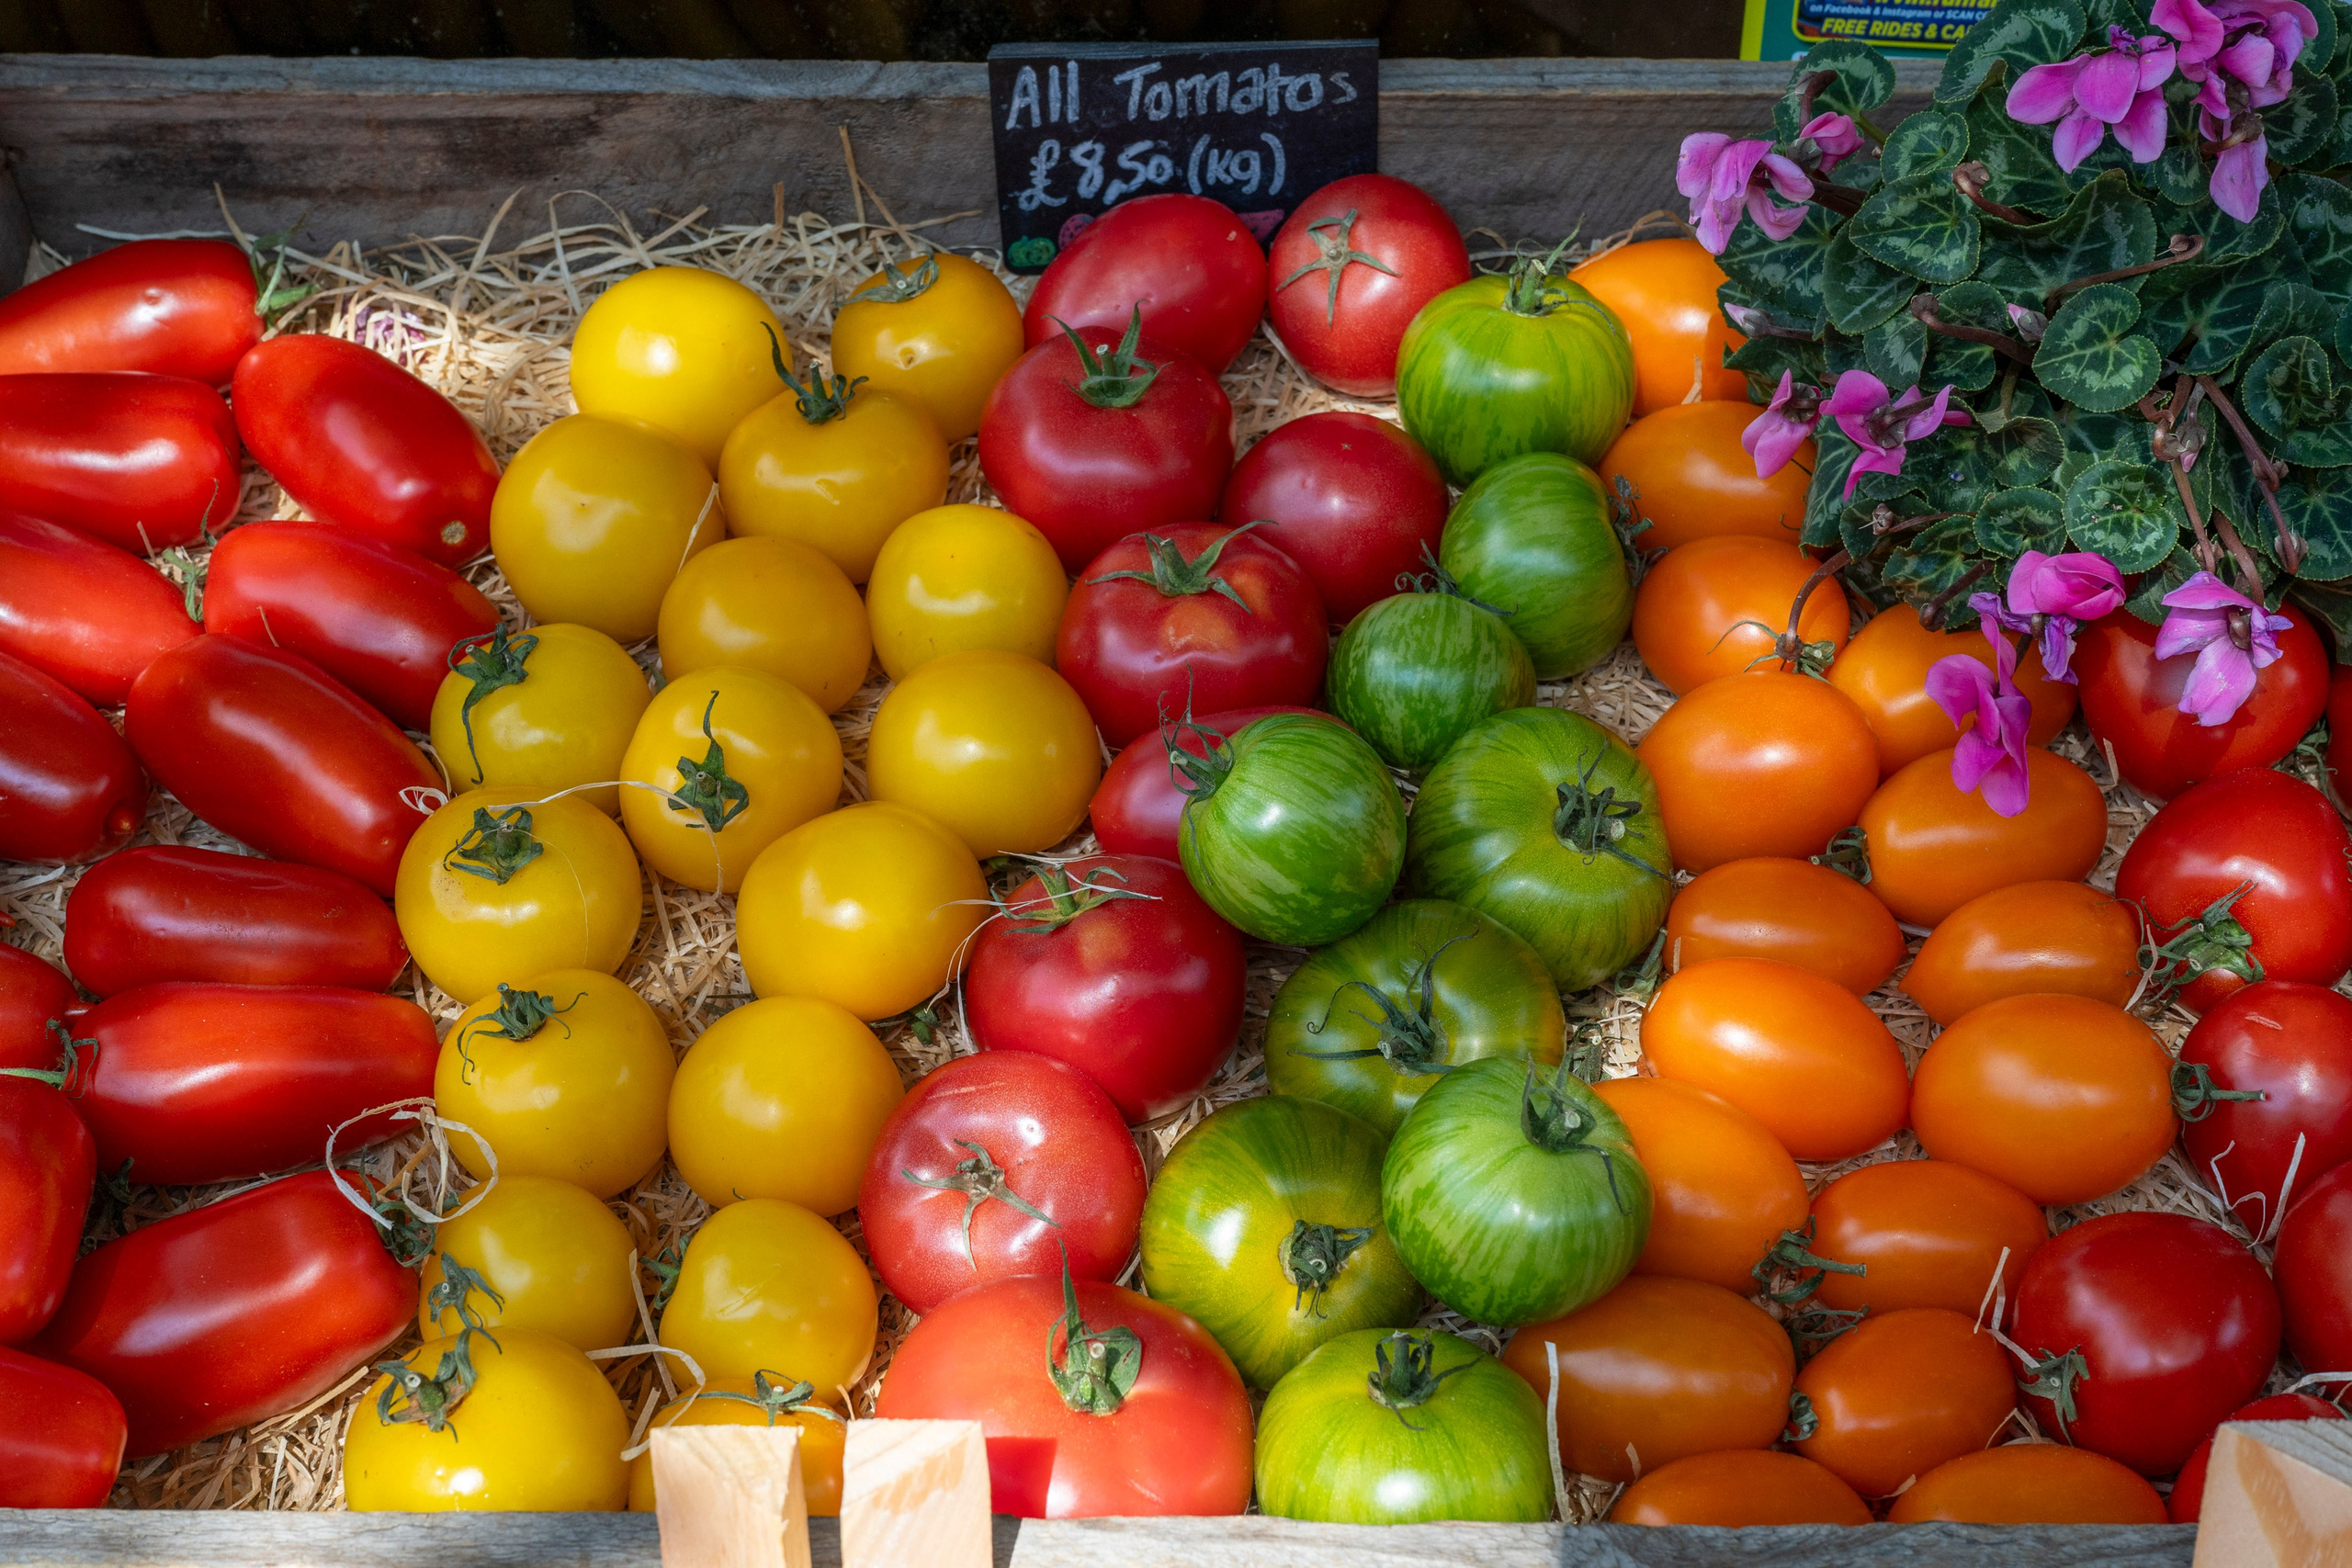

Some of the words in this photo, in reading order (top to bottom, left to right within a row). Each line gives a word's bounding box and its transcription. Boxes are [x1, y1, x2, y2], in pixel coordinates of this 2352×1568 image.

[1824, 3, 1871, 15] Facebook
[1872, 6, 1882, 16] &
[1882, 6, 1932, 19] Instagram
[1933, 10, 1945, 18] or
[1946, 9, 1975, 20] SCAN
[1820, 17, 1869, 36] FREE
[1869, 20, 1923, 38] RIDES
[1924, 23, 1938, 39] &
[1940, 24, 1973, 39] CA
[1005, 60, 1080, 130] All
[1113, 62, 1358, 121] Tomatos
